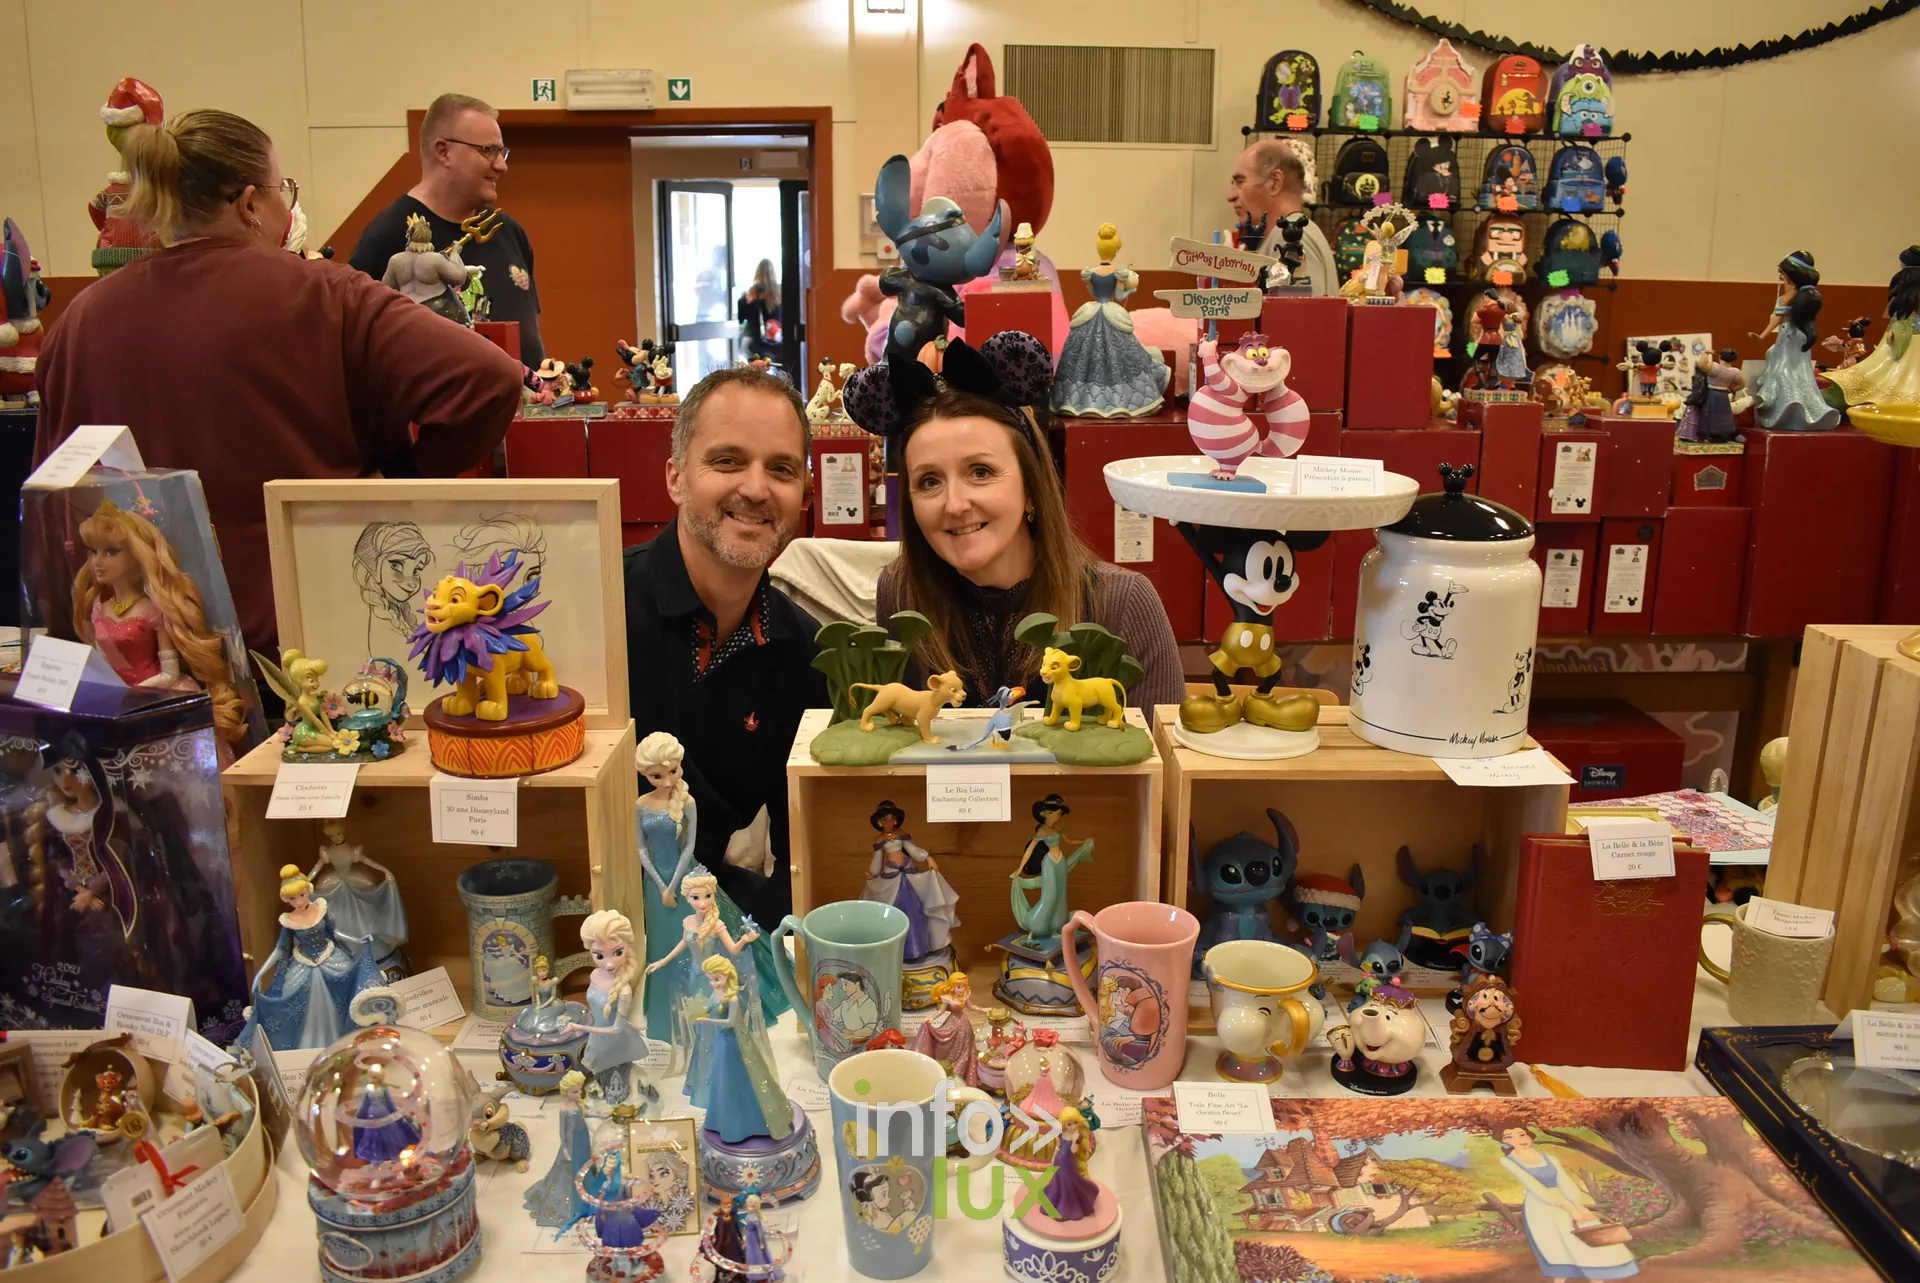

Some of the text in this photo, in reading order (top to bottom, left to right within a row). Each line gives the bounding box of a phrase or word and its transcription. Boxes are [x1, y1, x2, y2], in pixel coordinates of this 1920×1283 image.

[1176, 249, 1256, 278] Curious Labyrinth
[1182, 292, 1249, 306] Disneyland
[1200, 305, 1230, 317] Paris
[1313, 466, 1338, 474] Mickey
[1304, 473, 1340, 481] Présentoir
[1449, 731, 1500, 749] Mickey Mouse
[1588, 766, 1617, 780] Disney
[470, 806, 509, 815] Disneyland
[1637, 850, 1656, 858] rouge
[57, 962, 80, 975] 2021
[422, 996, 449, 1008] musicale
